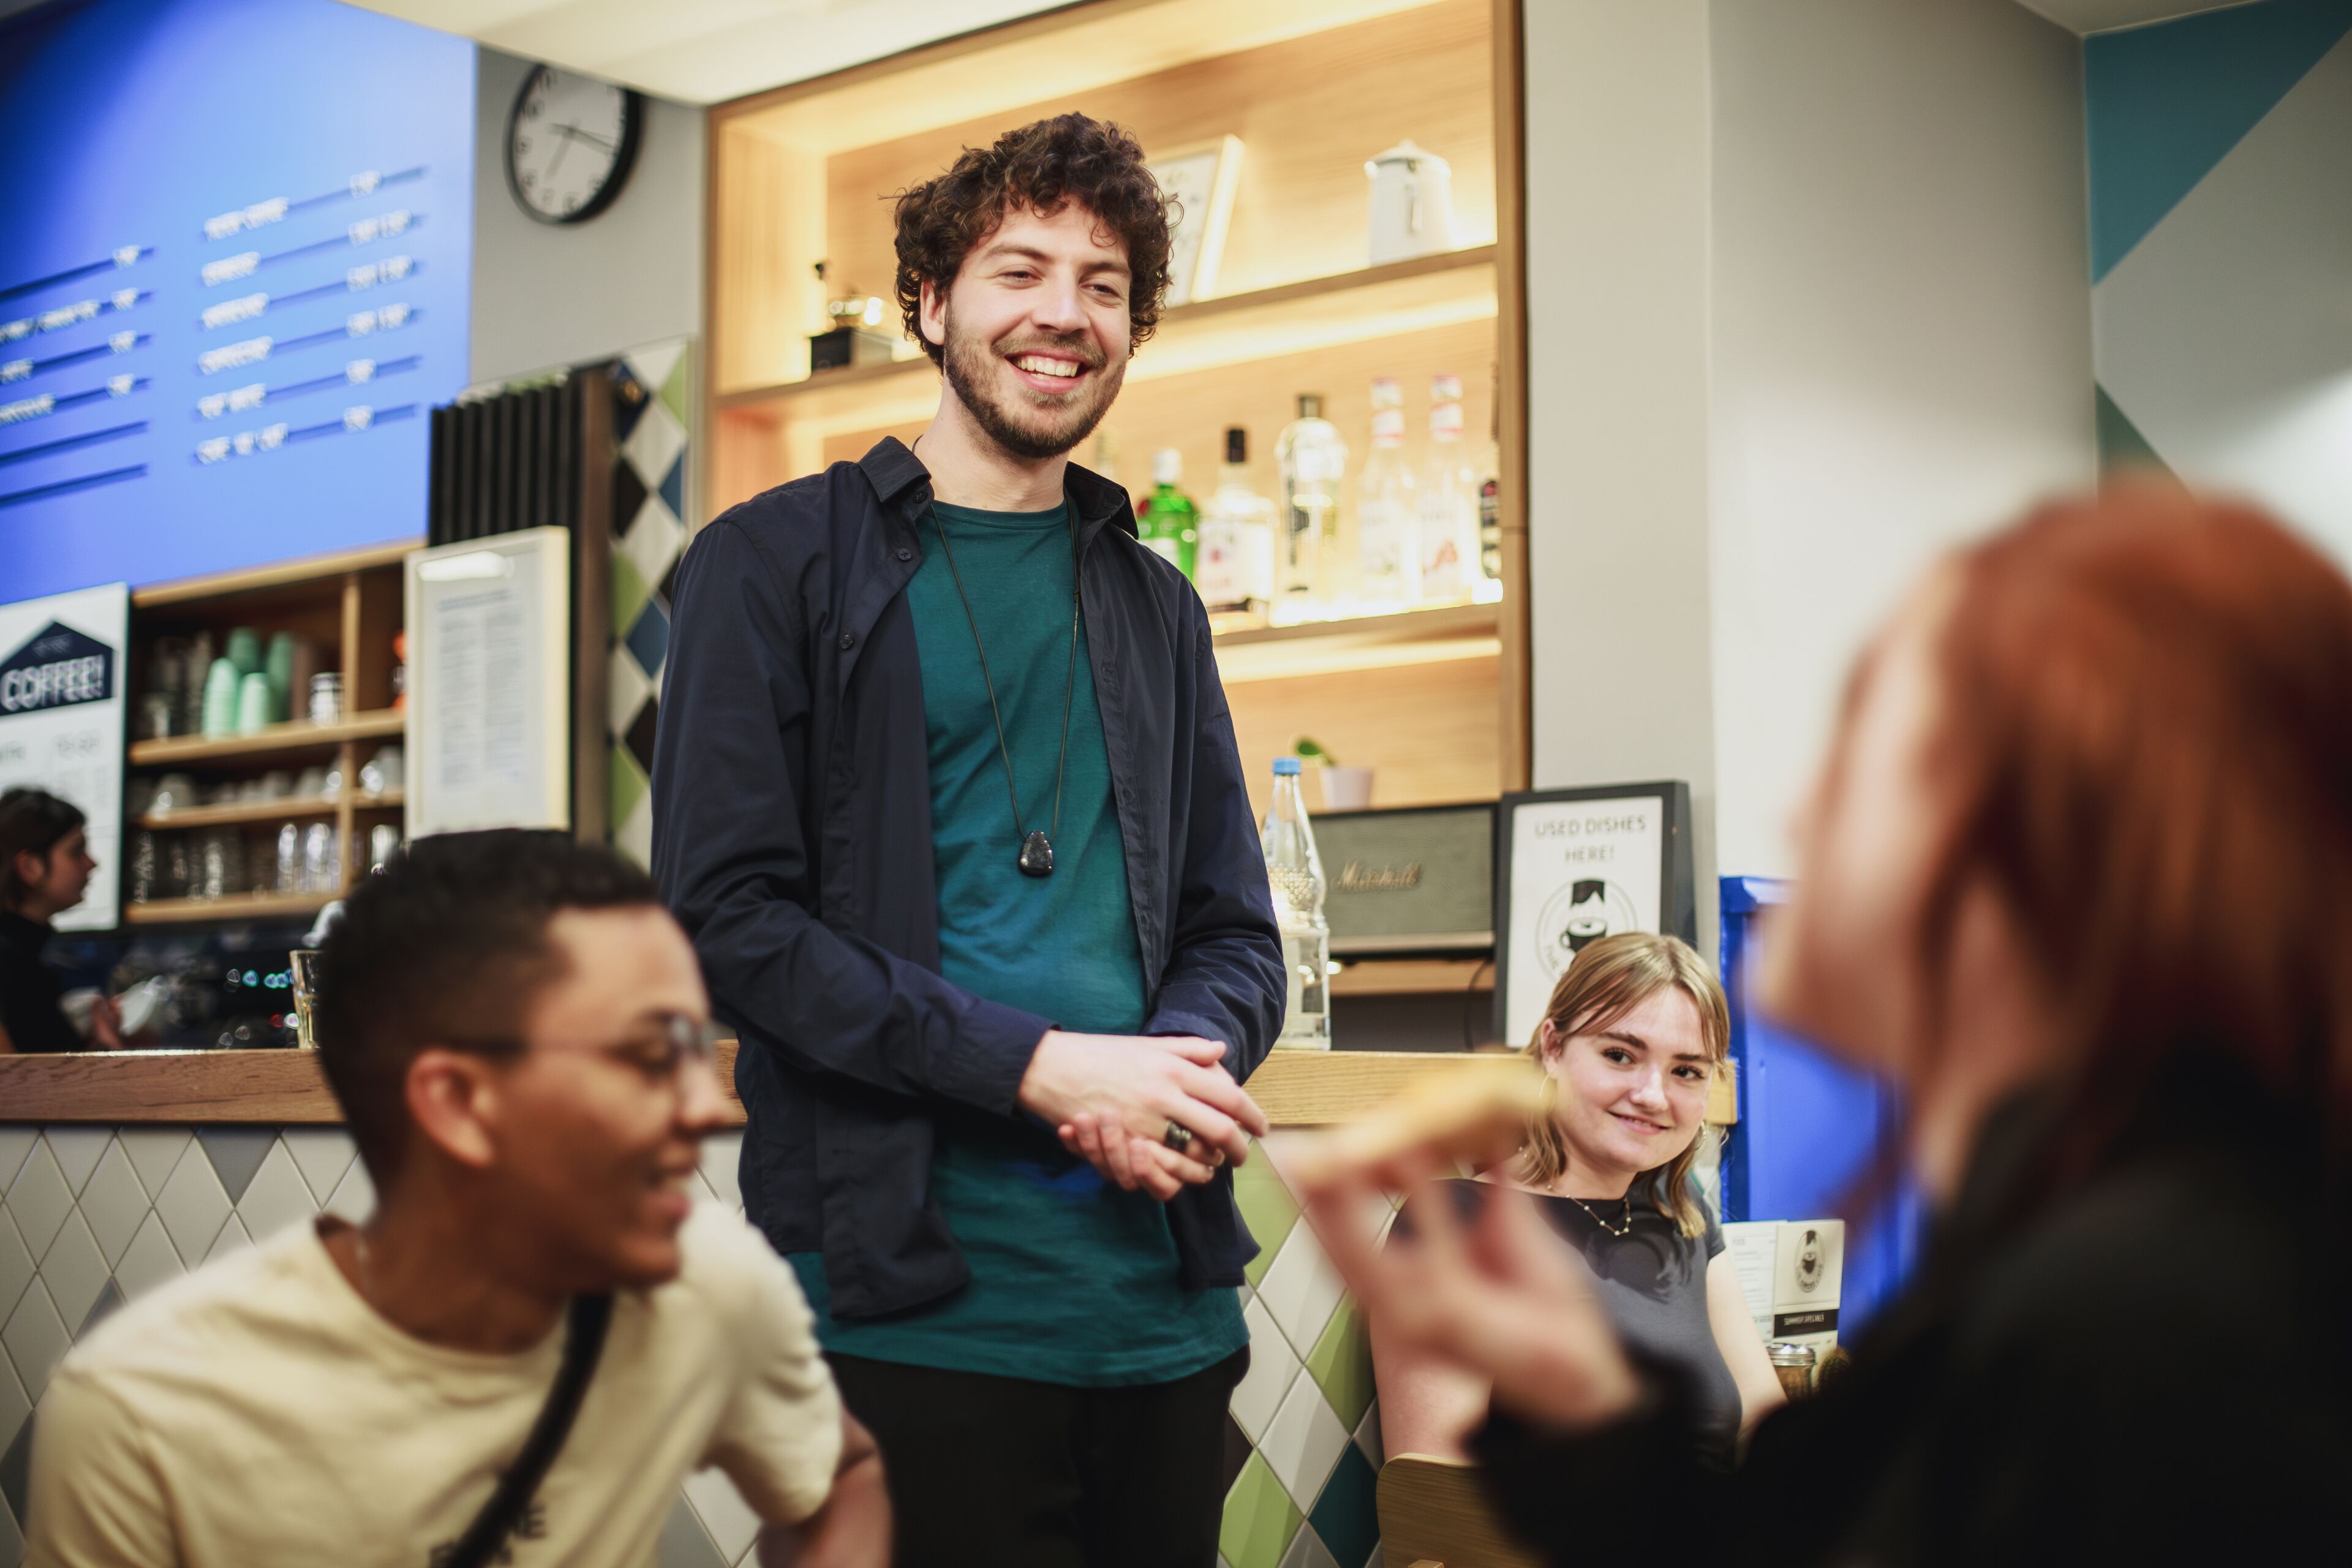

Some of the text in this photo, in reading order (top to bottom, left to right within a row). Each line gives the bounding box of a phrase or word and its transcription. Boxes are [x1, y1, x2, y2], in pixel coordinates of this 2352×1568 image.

[1, 653, 105, 711] COFFEE!
[1534, 814, 1647, 838] USED DISHES
[1565, 844, 1615, 862] HERE!
[1332, 860, 1422, 892] Marshall
